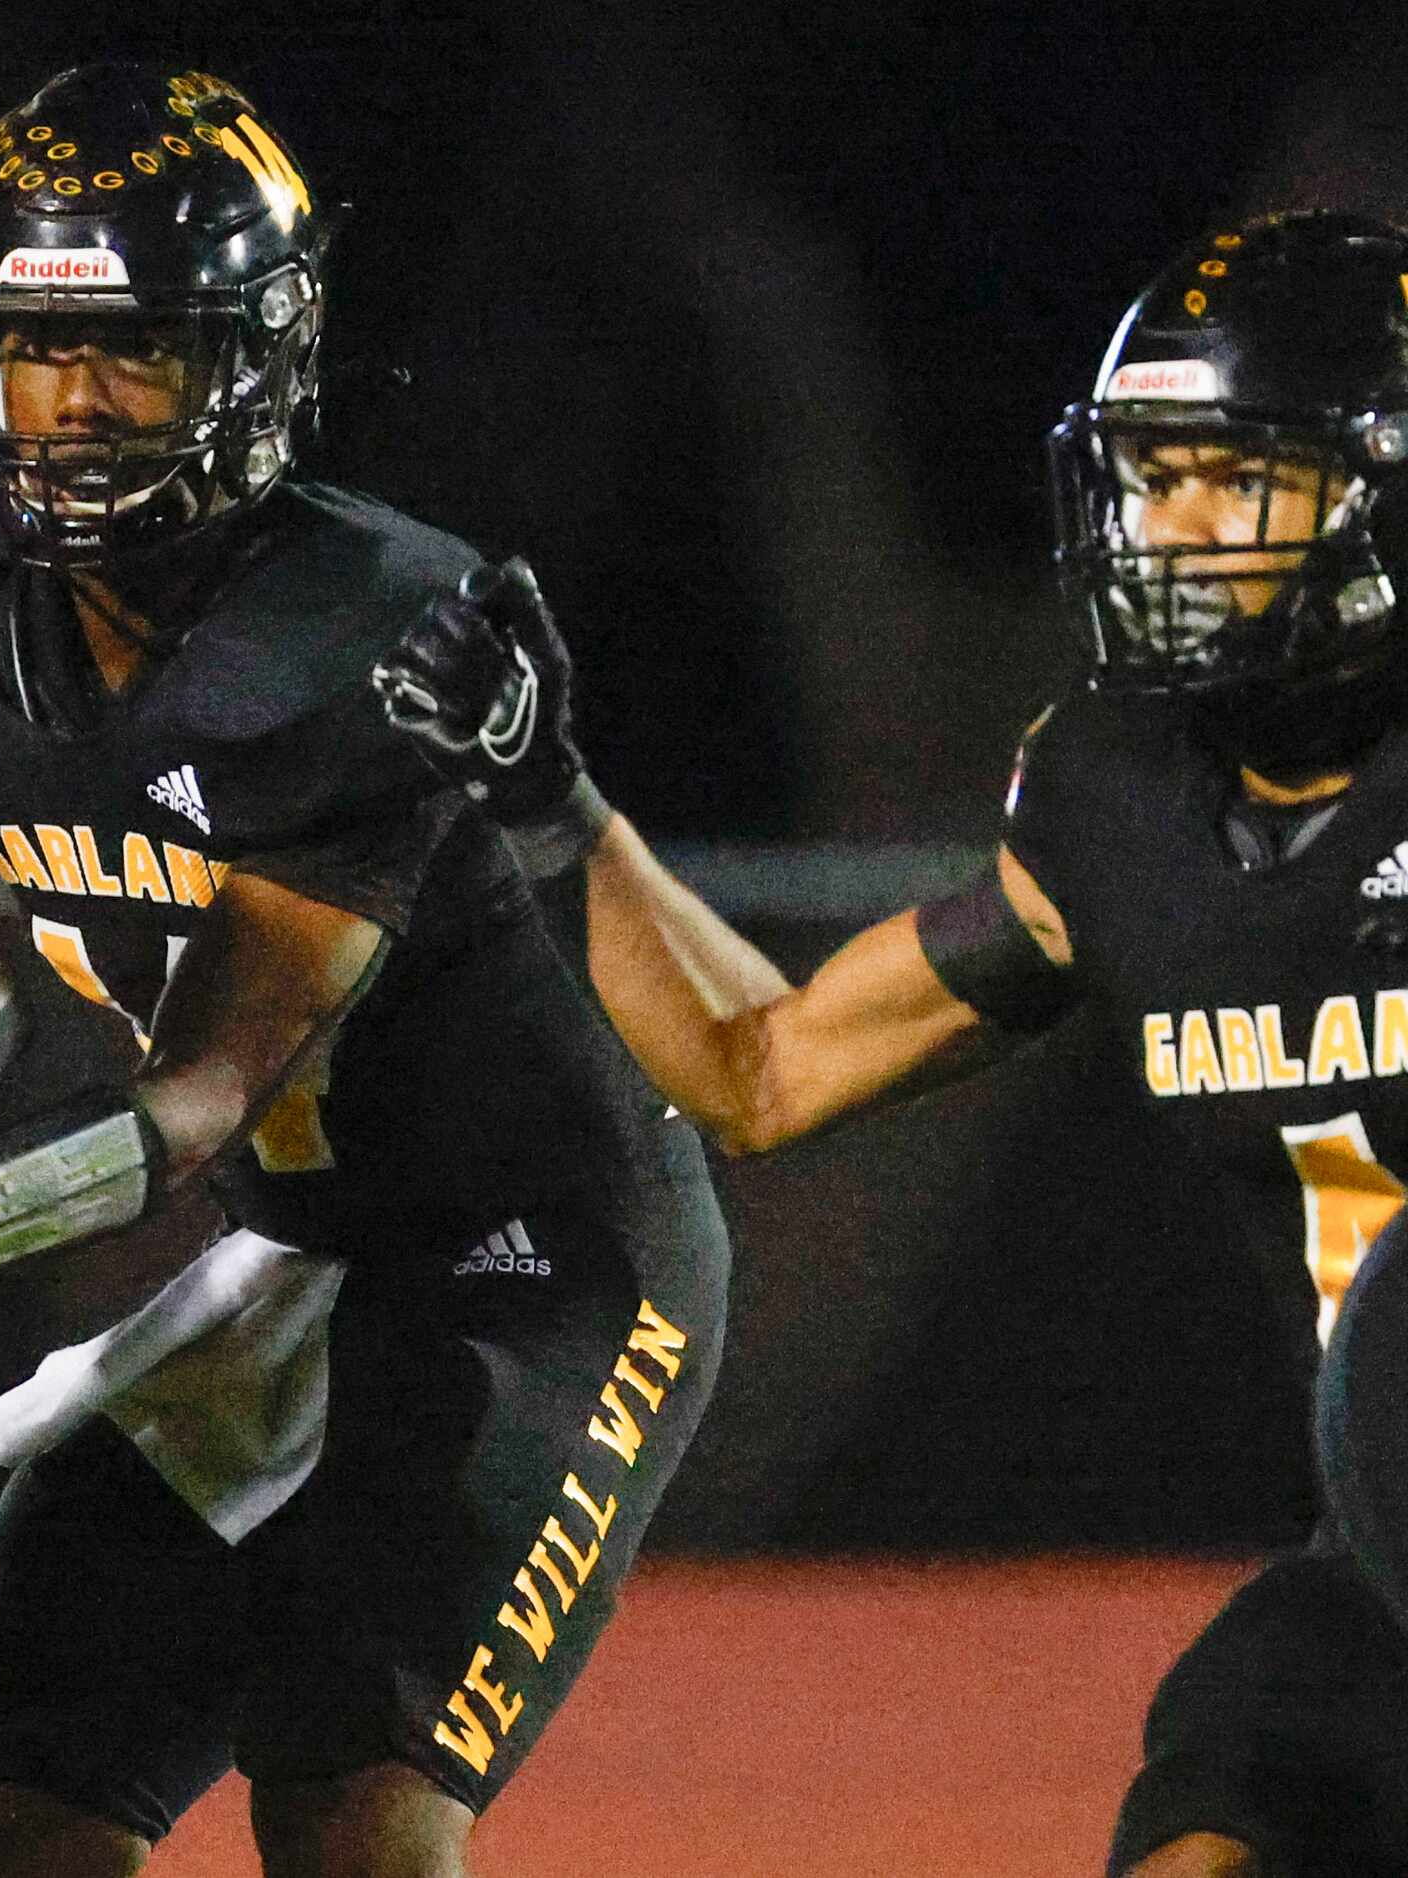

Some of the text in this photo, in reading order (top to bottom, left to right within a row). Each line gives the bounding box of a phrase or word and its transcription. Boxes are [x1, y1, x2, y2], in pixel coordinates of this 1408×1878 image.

[433, 1299, 688, 1777] WE WILL WIN
